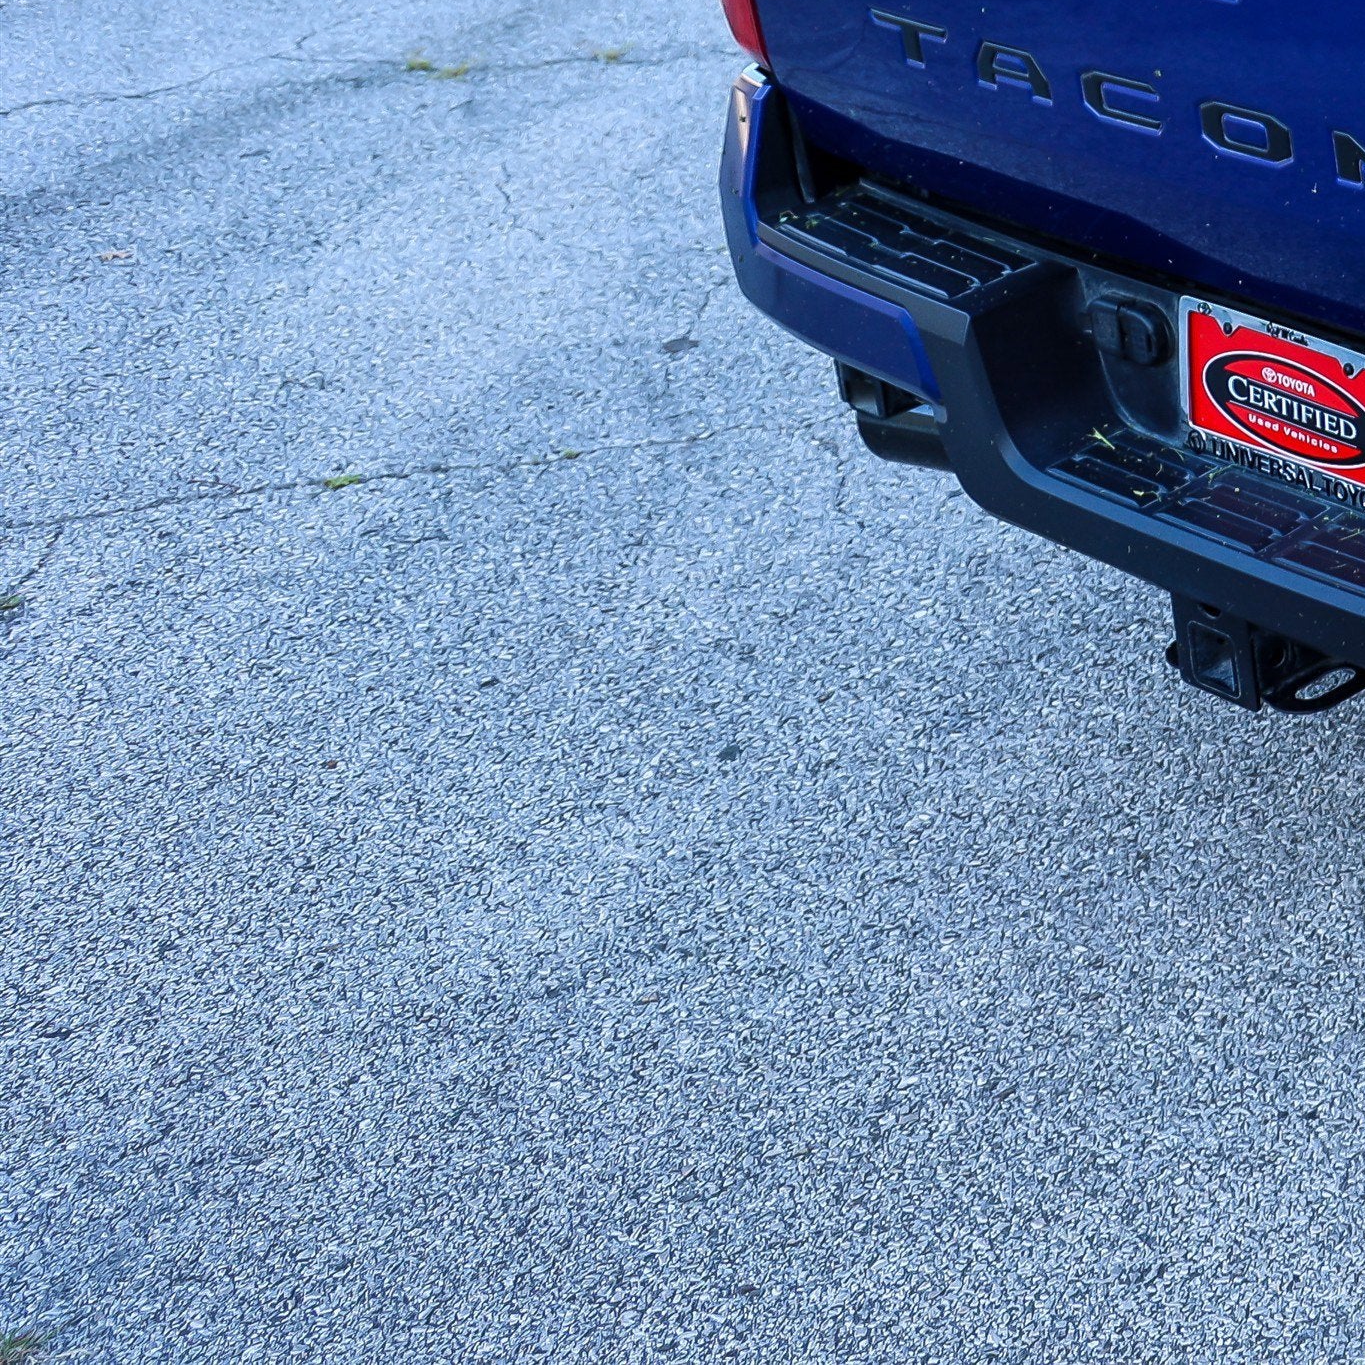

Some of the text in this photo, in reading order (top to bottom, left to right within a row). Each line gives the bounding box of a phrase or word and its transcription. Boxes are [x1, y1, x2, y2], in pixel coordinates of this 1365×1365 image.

[1227, 374, 1358, 441] CERTIFIED
[1276, 373, 1316, 398] TOYOTA
[1248, 413, 1339, 455] Used Vehicles
[1211, 437, 1322, 492] UNIVERSAL
